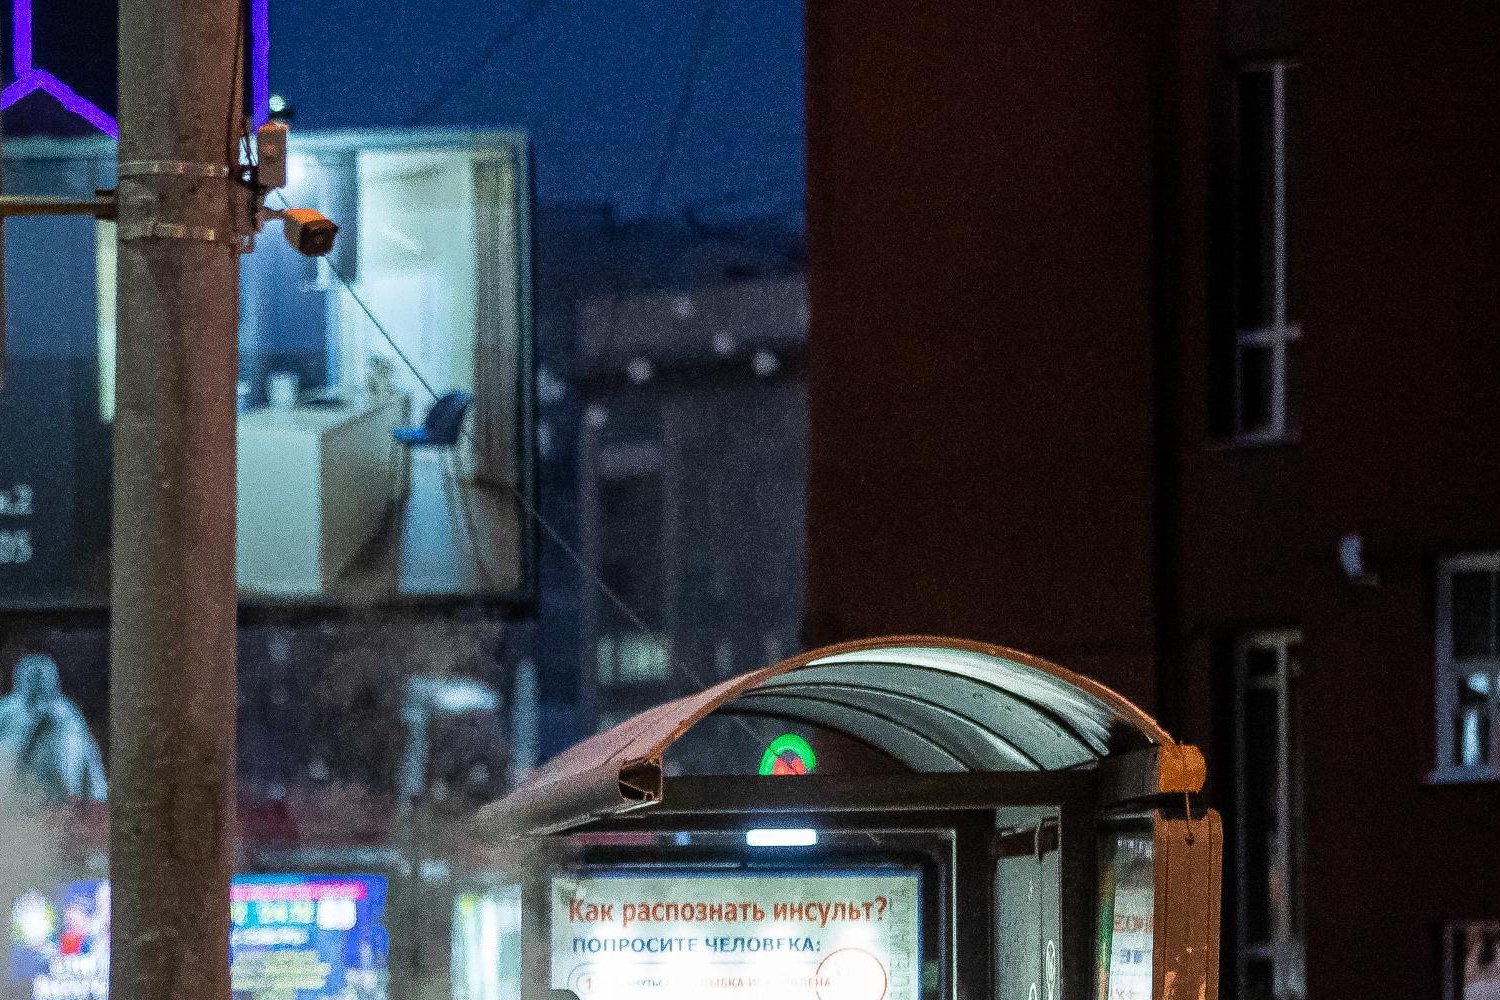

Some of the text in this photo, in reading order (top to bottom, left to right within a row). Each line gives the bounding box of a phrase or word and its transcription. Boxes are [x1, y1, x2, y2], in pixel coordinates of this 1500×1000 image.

[569, 895, 889, 929] Как распознать инсульт?
[573, 936, 822, 954] ПОПРОСИТЕ ЧЕЛОВЕКА:
